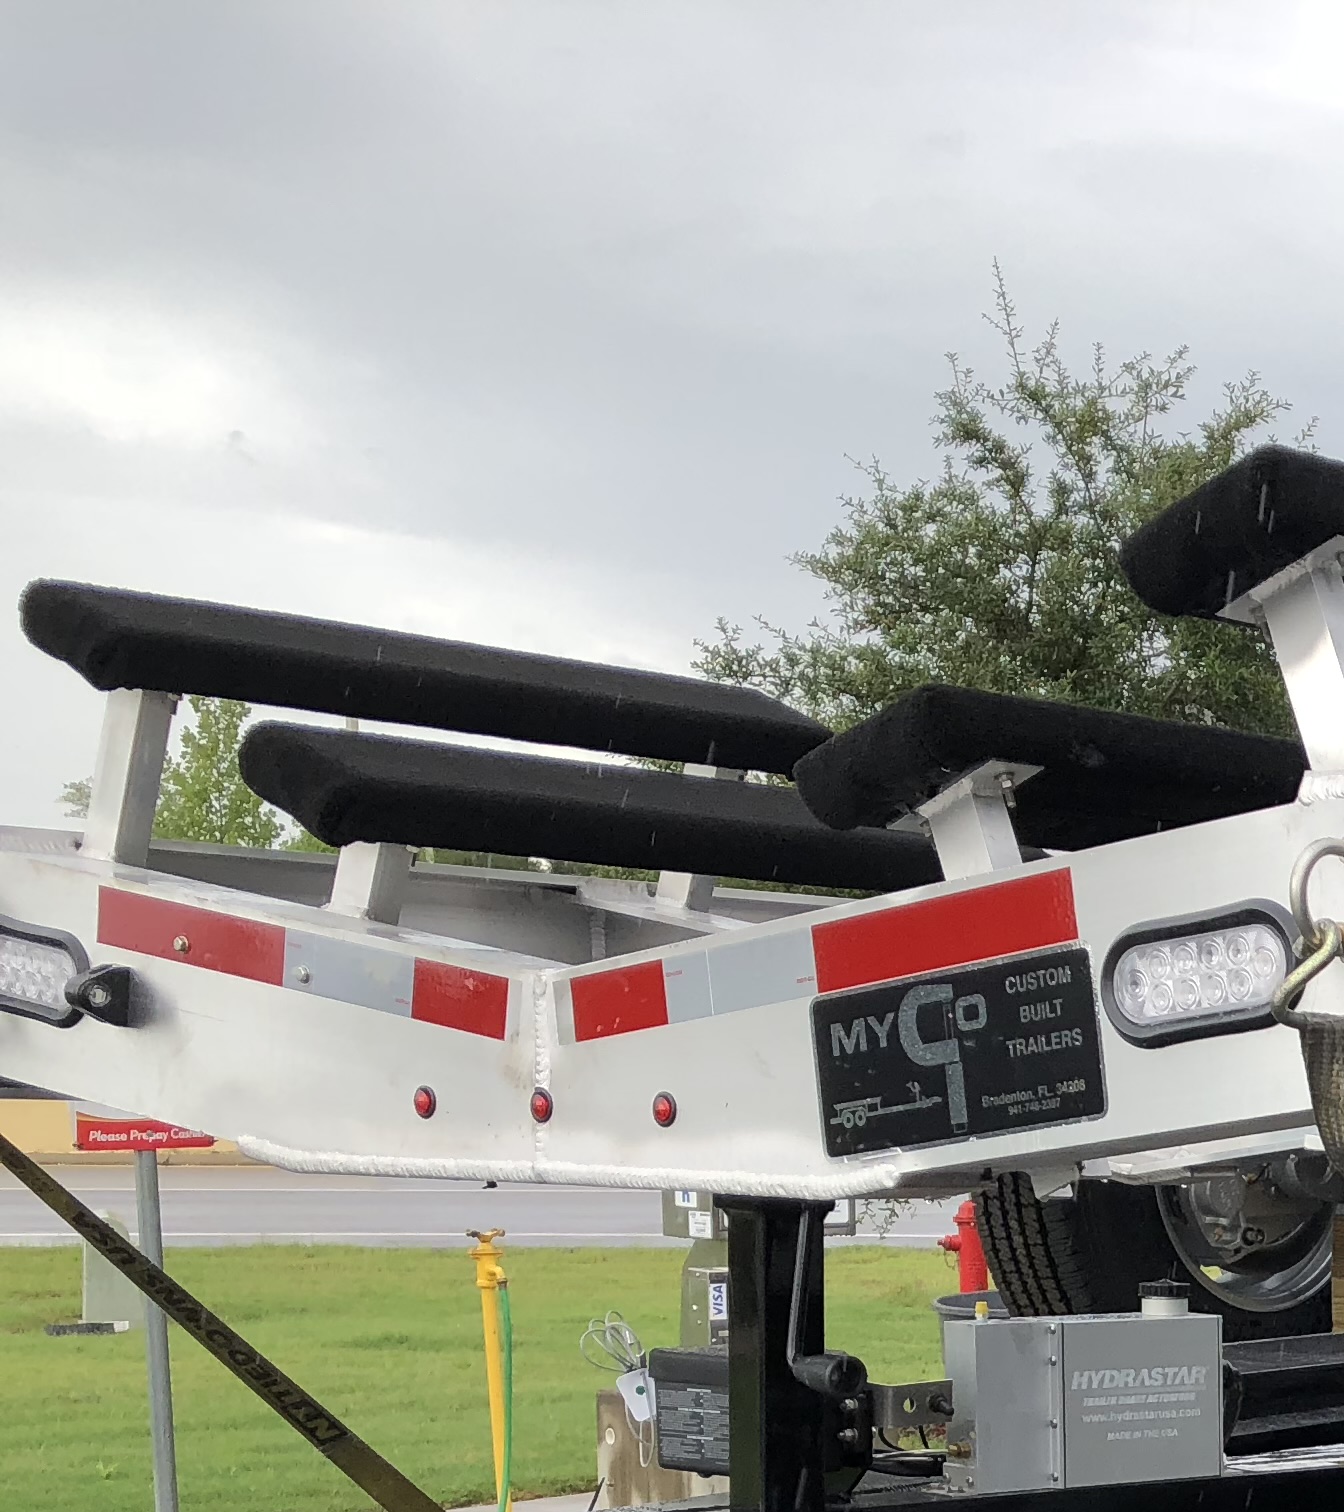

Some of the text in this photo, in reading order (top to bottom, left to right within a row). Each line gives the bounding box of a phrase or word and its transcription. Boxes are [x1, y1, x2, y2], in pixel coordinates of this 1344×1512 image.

[1005, 965, 1072, 994] CUSTOM
[1019, 999, 1064, 1024] BUILT
[1006, 1027, 1083, 1058] TRAILERS
[88, 1130, 128, 1142] Please
[710, 1285, 724, 1316] VISA
[1071, 1366, 1207, 1390] HYDRASTAR
[1081, 1408, 1201, 1423] www.hydrastarusa.com
[1107, 1431, 1132, 1441] MADE
[1133, 1430, 1142, 1439] IN
[1143, 1429, 1159, 1438] THE
